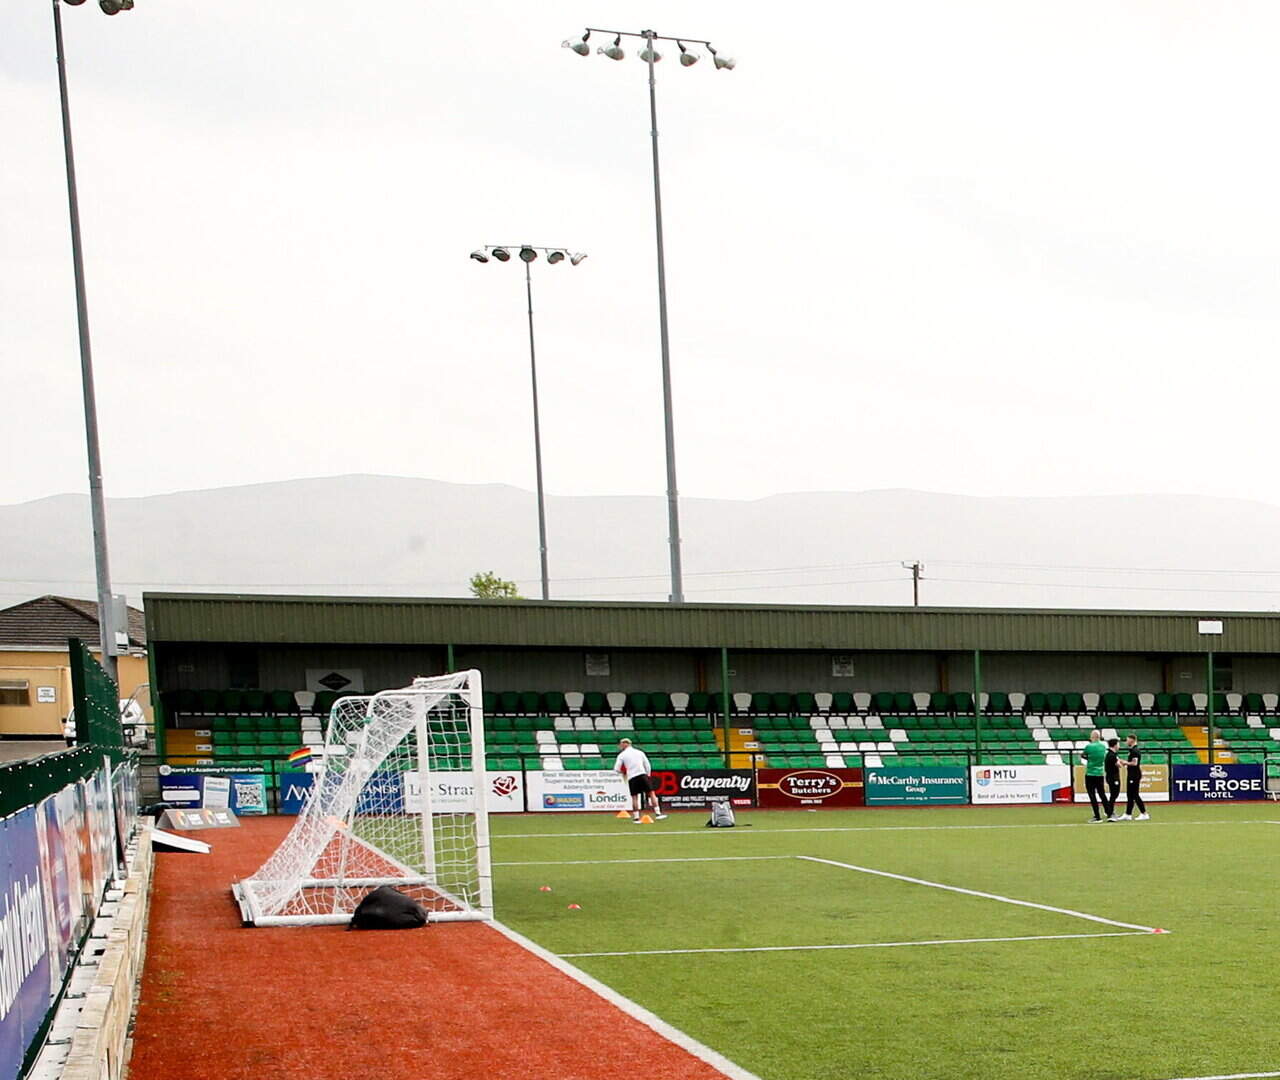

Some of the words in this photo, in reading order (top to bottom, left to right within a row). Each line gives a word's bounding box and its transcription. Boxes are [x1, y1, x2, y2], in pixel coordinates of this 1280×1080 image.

[993, 770, 1017, 779] MTU
[680, 775, 752, 792] Carpentry
[787, 776, 837, 788] Terry's
[877, 775, 920, 786] McCarthy
[922, 776, 964, 784] Insurance
[1176, 780, 1210, 792] THE
[1215, 779, 1261, 791] ROSE
[905, 785, 926, 793] Group
[589, 793, 627, 803] Londis
[1204, 791, 1234, 799] HOTEL
